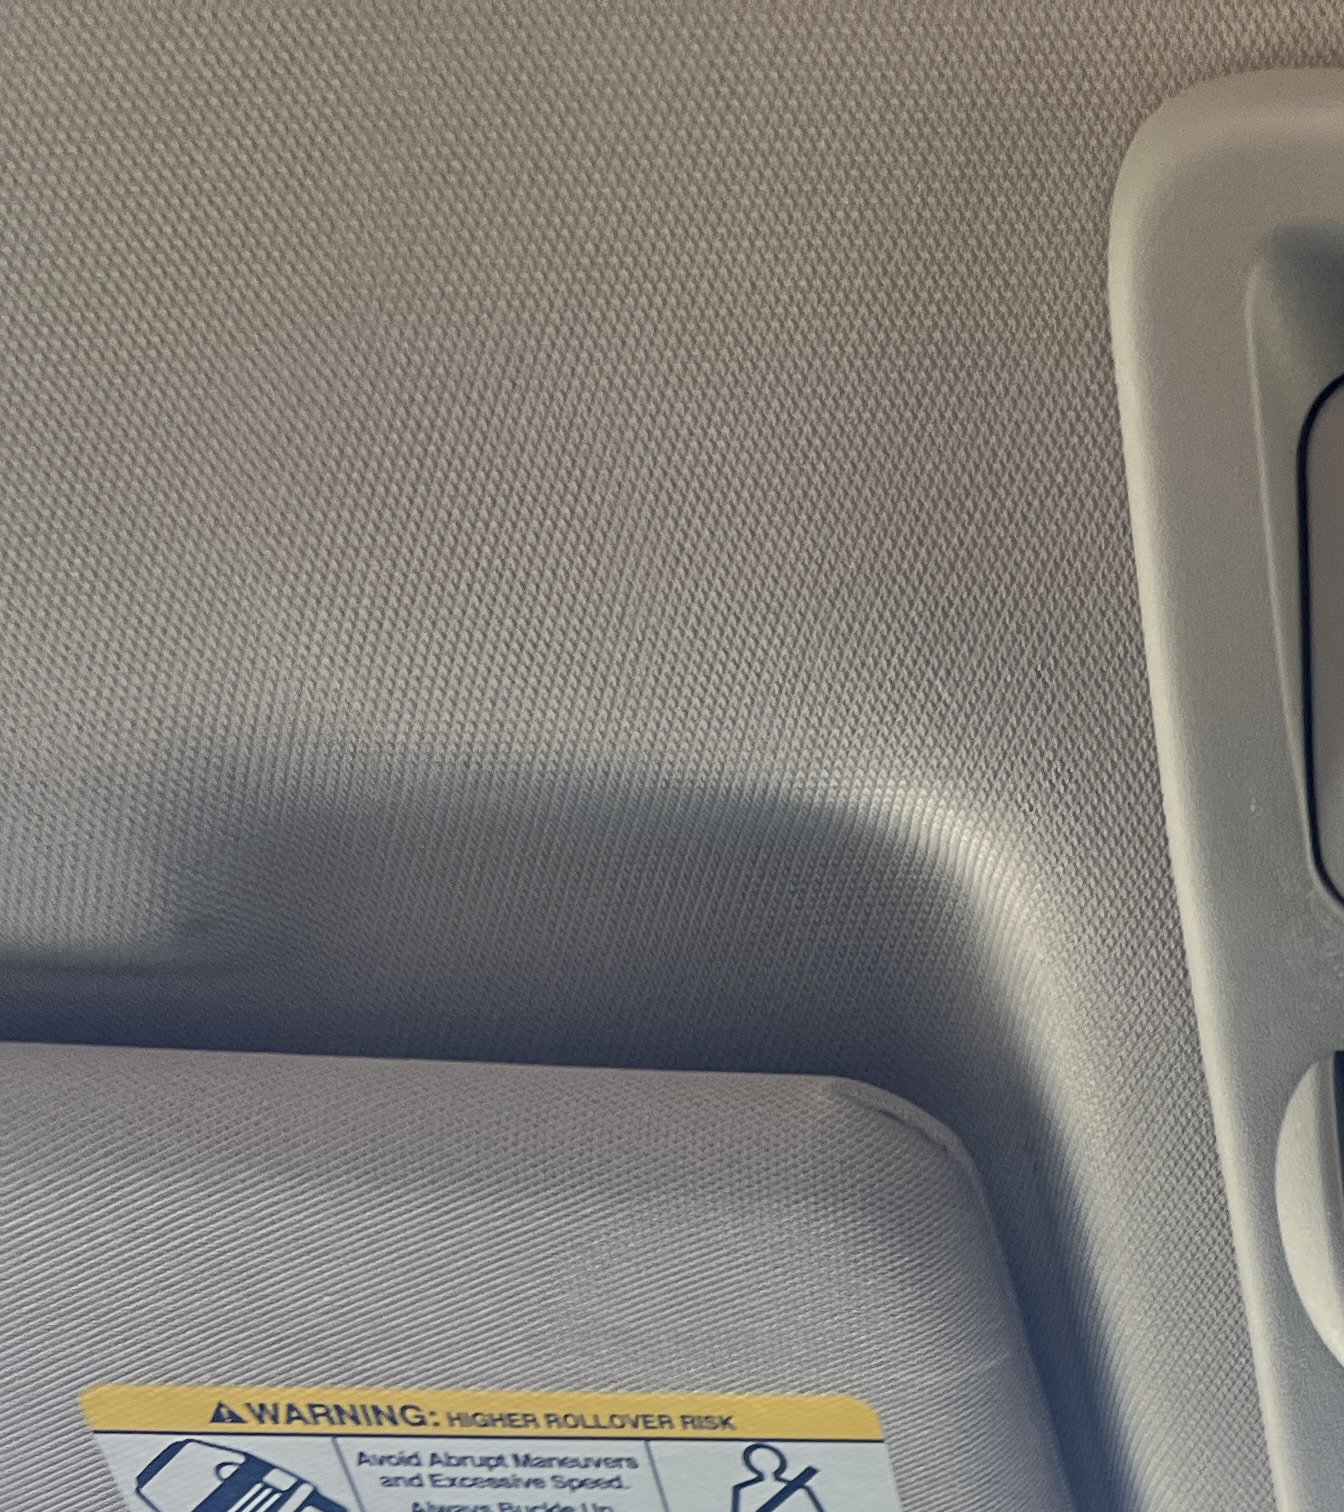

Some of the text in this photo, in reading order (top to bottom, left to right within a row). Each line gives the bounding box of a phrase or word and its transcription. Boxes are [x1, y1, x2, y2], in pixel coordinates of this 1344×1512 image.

[246, 1402, 736, 1431] WARNING: HIGHER ROLLOVER RISK
[358, 1451, 639, 1471] Avoid Abrupt Maneuvers
[380, 1473, 632, 1493] and Excessive Speed.
